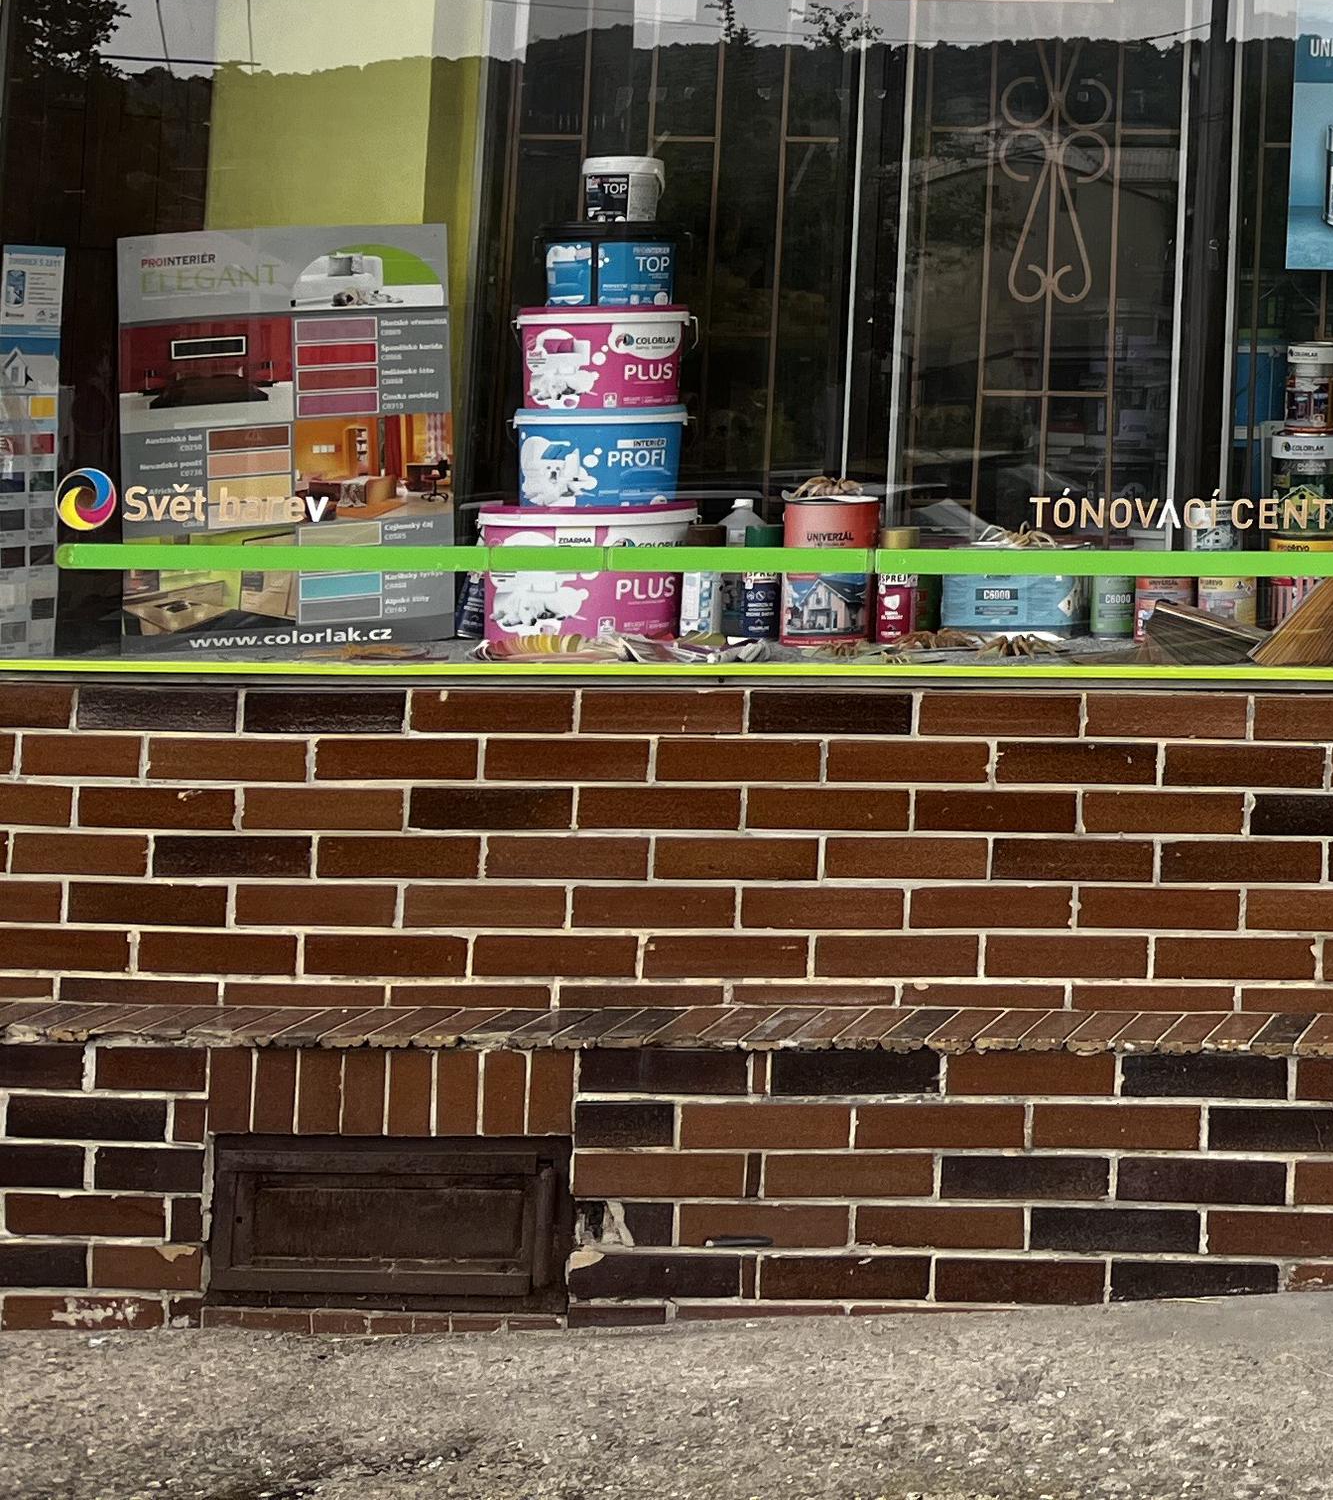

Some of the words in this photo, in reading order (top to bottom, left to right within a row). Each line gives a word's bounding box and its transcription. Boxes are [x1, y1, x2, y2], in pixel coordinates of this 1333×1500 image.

[603, 182, 628, 195] TOP
[635, 256, 671, 273] TOP
[141, 263, 281, 294] ELEGANT
[635, 336, 677, 346] COLORLAK
[623, 363, 673, 381] PLUS
[607, 449, 666, 467] PROFI
[123, 483, 207, 522] Svět
[218, 487, 330, 523] barev
[1030, 486, 1220, 531] TÓNOVACÍ
[806, 531, 855, 542] UNIVERZÁL
[616, 577, 676, 601] PLUS
[982, 588, 1011, 600] C6000
[1105, 593, 1132, 605] C6000
[189, 626, 393, 650] www.colorlak.cz
